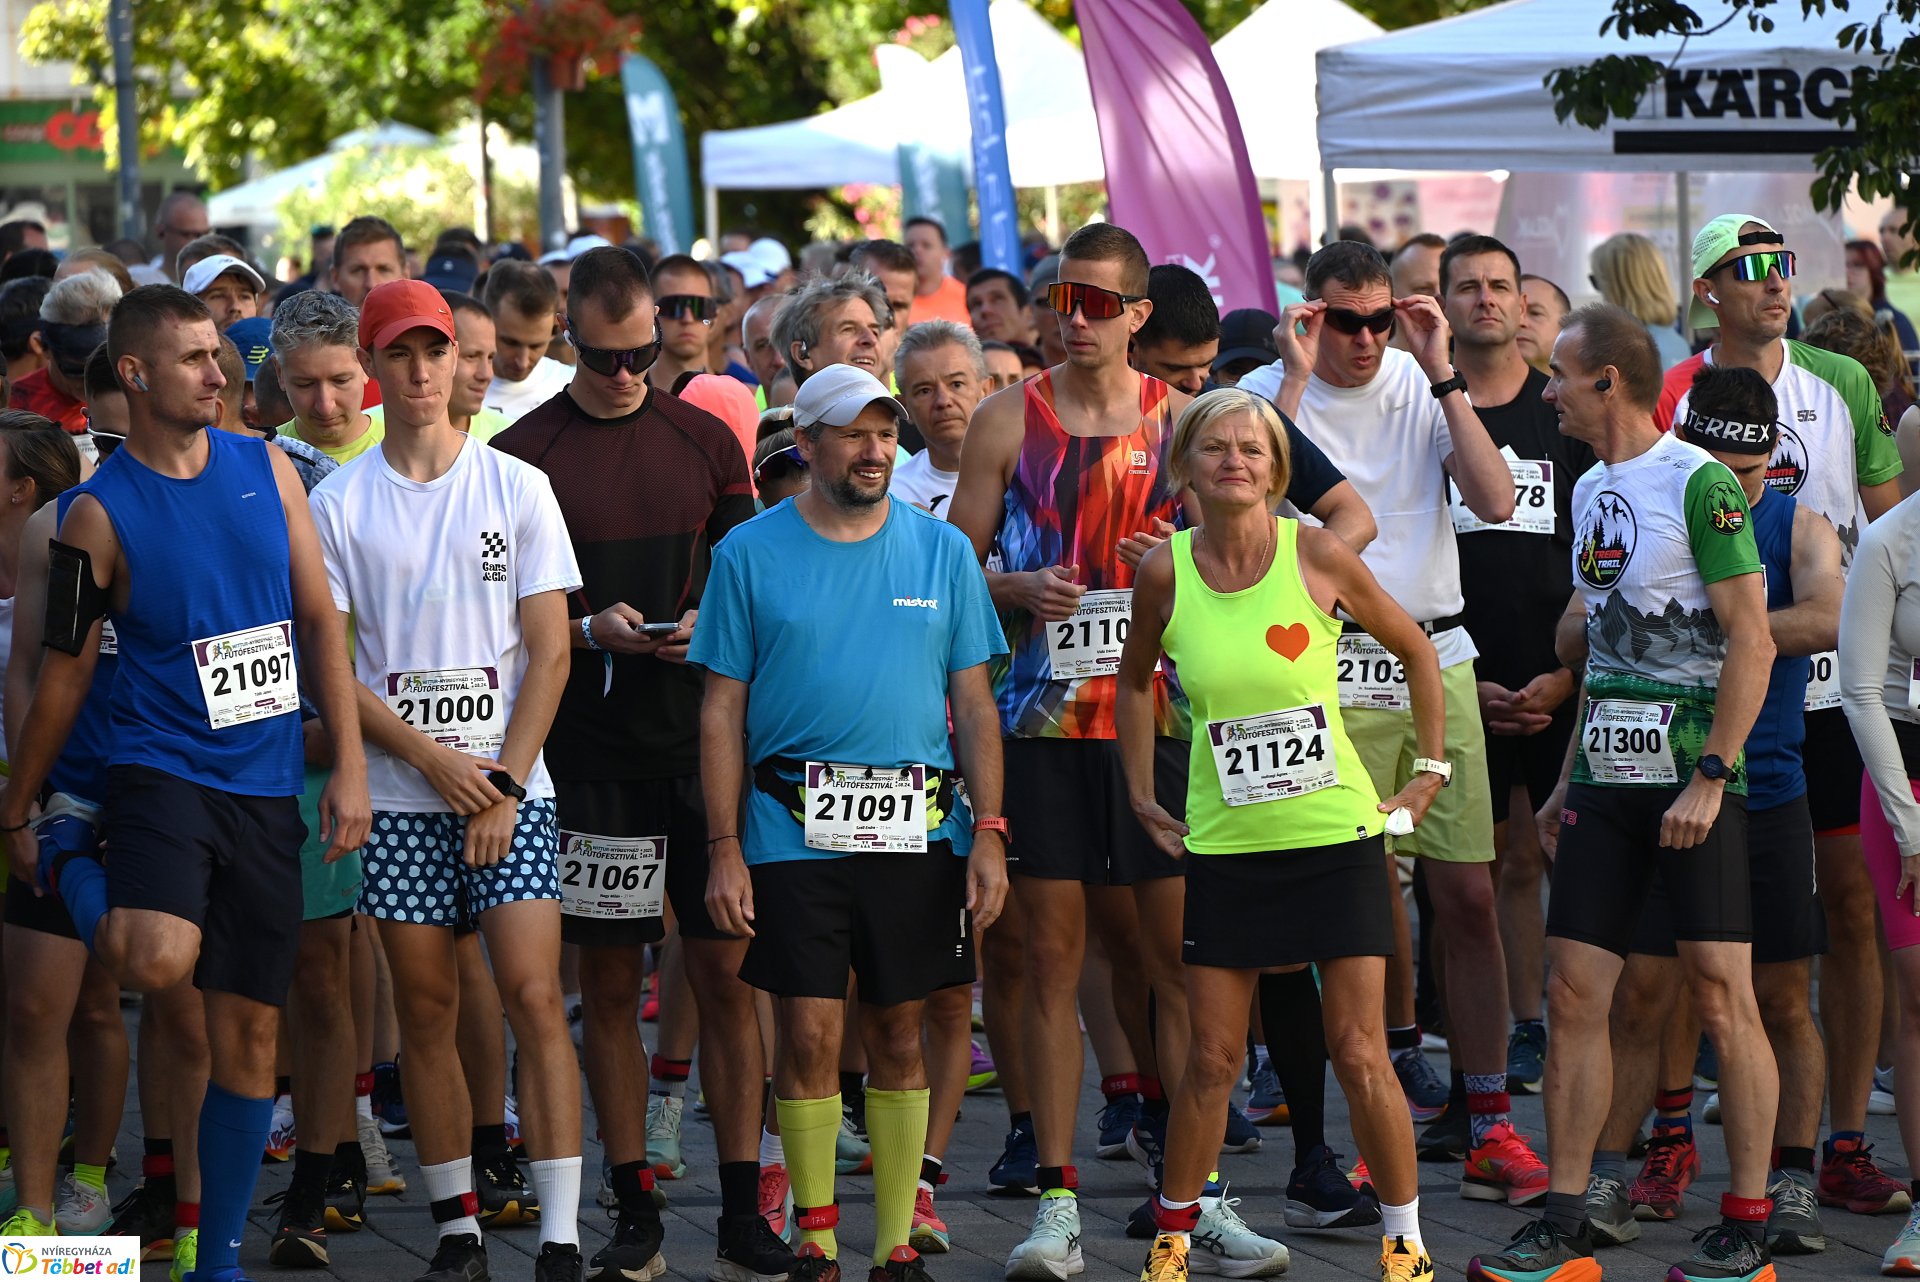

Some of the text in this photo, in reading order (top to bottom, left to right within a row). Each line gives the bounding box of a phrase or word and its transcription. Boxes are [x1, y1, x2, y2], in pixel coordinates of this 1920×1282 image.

[1687, 410, 1770, 443] TERREX
[1765, 468, 1797, 478] REME
[1763, 477, 1797, 486] TRAIL
[482, 561, 507, 572] Cars
[1597, 559, 1621, 569] TRAIL
[892, 595, 938, 610] mistral
[1057, 618, 1131, 650] 2110
[1353, 647, 1390, 655] FUTÓFESZ
[211, 652, 290, 696] 21097
[1337, 659, 1407, 684] 2103
[413, 682, 470, 693] FUTÓFESZTIVÁL
[397, 694, 494, 726] 21000
[1238, 726, 1295, 740] FUTÓFESZTIVÁL
[1589, 727, 1661, 754] 21300
[1225, 734, 1325, 776] 21124
[835, 780, 893, 789] FUTÓFESZTIVÁL
[815, 793, 913, 822] 21091
[582, 850, 638, 860] FUTÓFESZTIVÁL
[562, 860, 659, 890] 21067
[811, 1215, 826, 1225] 174
